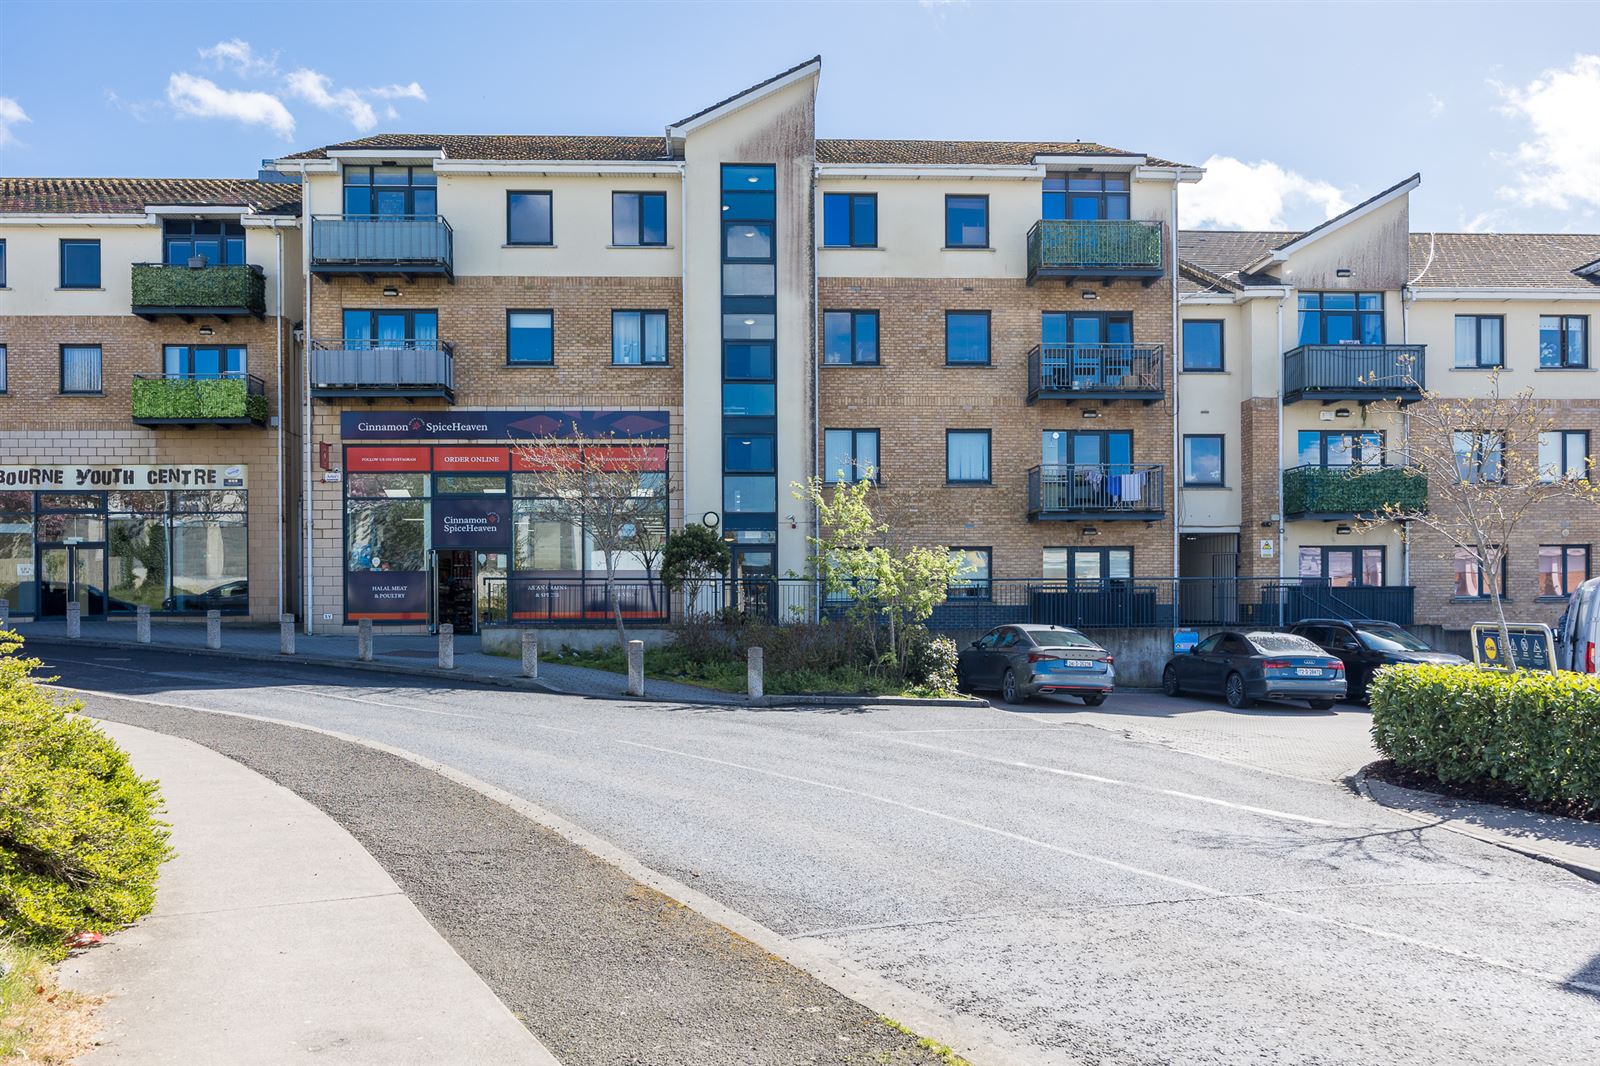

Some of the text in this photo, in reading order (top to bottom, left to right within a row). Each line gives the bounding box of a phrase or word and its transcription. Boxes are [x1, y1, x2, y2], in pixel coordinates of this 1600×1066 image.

[358, 422, 488, 433] Cinnamon SpiceHeaven
[76, 468, 134, 486] YOUTH
[147, 468, 216, 485] CENTRE
[443, 515, 487, 525] Cinnamon
[443, 524, 497, 533] SpiceHeaven
